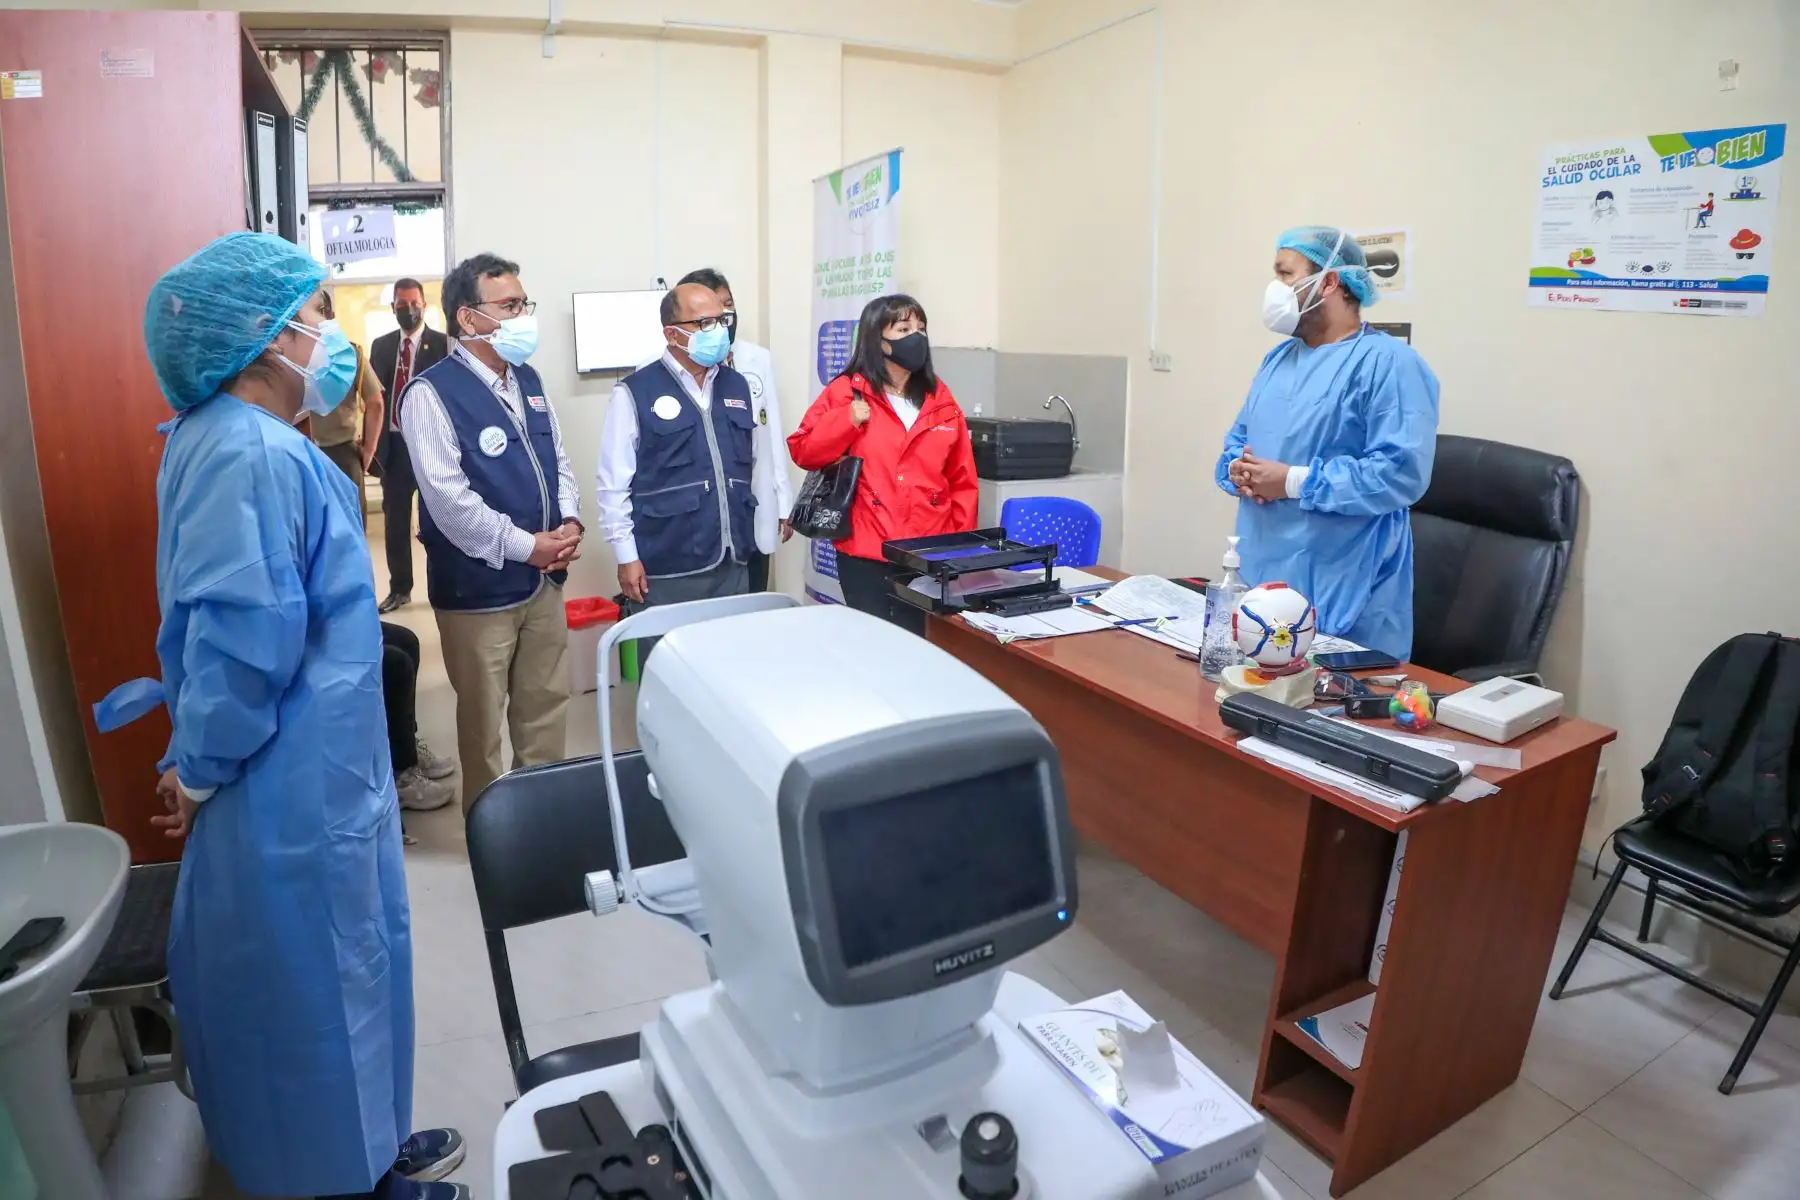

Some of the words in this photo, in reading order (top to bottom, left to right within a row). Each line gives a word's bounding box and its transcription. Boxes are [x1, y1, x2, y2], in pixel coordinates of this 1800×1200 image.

[1603, 148, 1626, 157] PARA
[1716, 130, 1766, 167] BIEN
[1542, 172, 1583, 188] SALUD
[1589, 163, 1641, 181] OCULAR
[1547, 167, 1557, 175] EL
[1607, 156, 1619, 166] DE
[1623, 154, 1635, 164] LA
[353, 214, 364, 233] 2
[935, 944, 994, 973] HUVITZ
